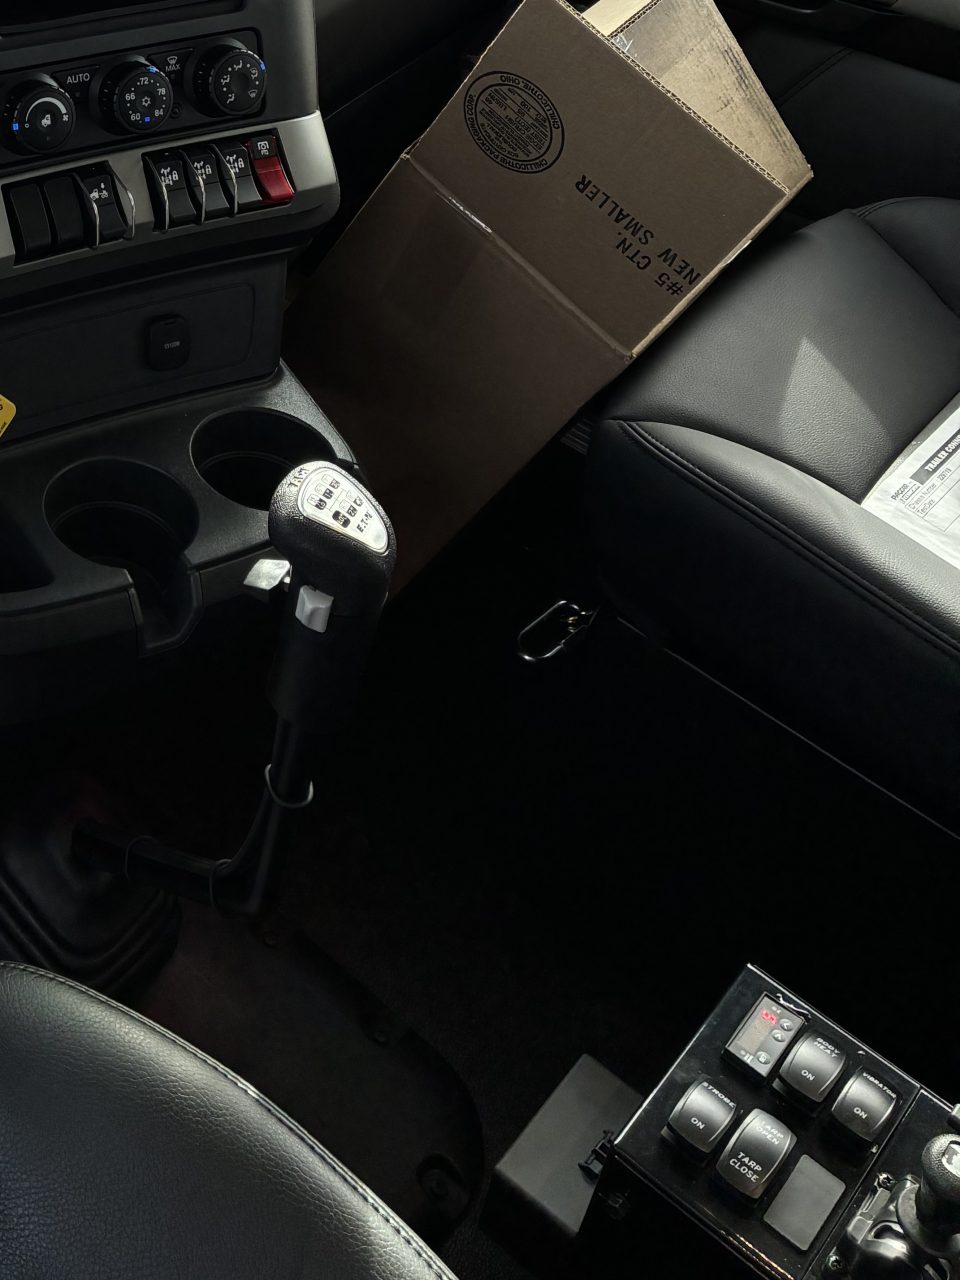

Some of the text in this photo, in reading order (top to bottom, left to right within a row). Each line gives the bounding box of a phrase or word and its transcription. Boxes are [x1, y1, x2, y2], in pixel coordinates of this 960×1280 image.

[165, 63, 181, 72] MAX
[66, 72, 90, 85] AUTO
[139, 76, 149, 86] 72
[500, 74, 520, 85] OHIO
[125, 92, 135, 101] 66
[156, 87, 166, 96] 78
[130, 112, 141, 121] 60
[154, 108, 164, 117] 84
[469, 116, 500, 160] PACKAGING
[575, 174, 701, 286] NEW SMALLER
[616, 232, 683, 296] #5 CTN.
[813, 1041, 838, 1058] HEAT
[816, 1037, 840, 1054] BODY
[801, 1069, 815, 1081] ON
[862, 1072, 897, 1099] VIBRATOR
[703, 1081, 737, 1108] STROBE
[853, 1107, 868, 1119] ON
[690, 1116, 705, 1130] ON
[737, 1151, 762, 1172] TARP
[729, 1158, 760, 1183] CLOSE
